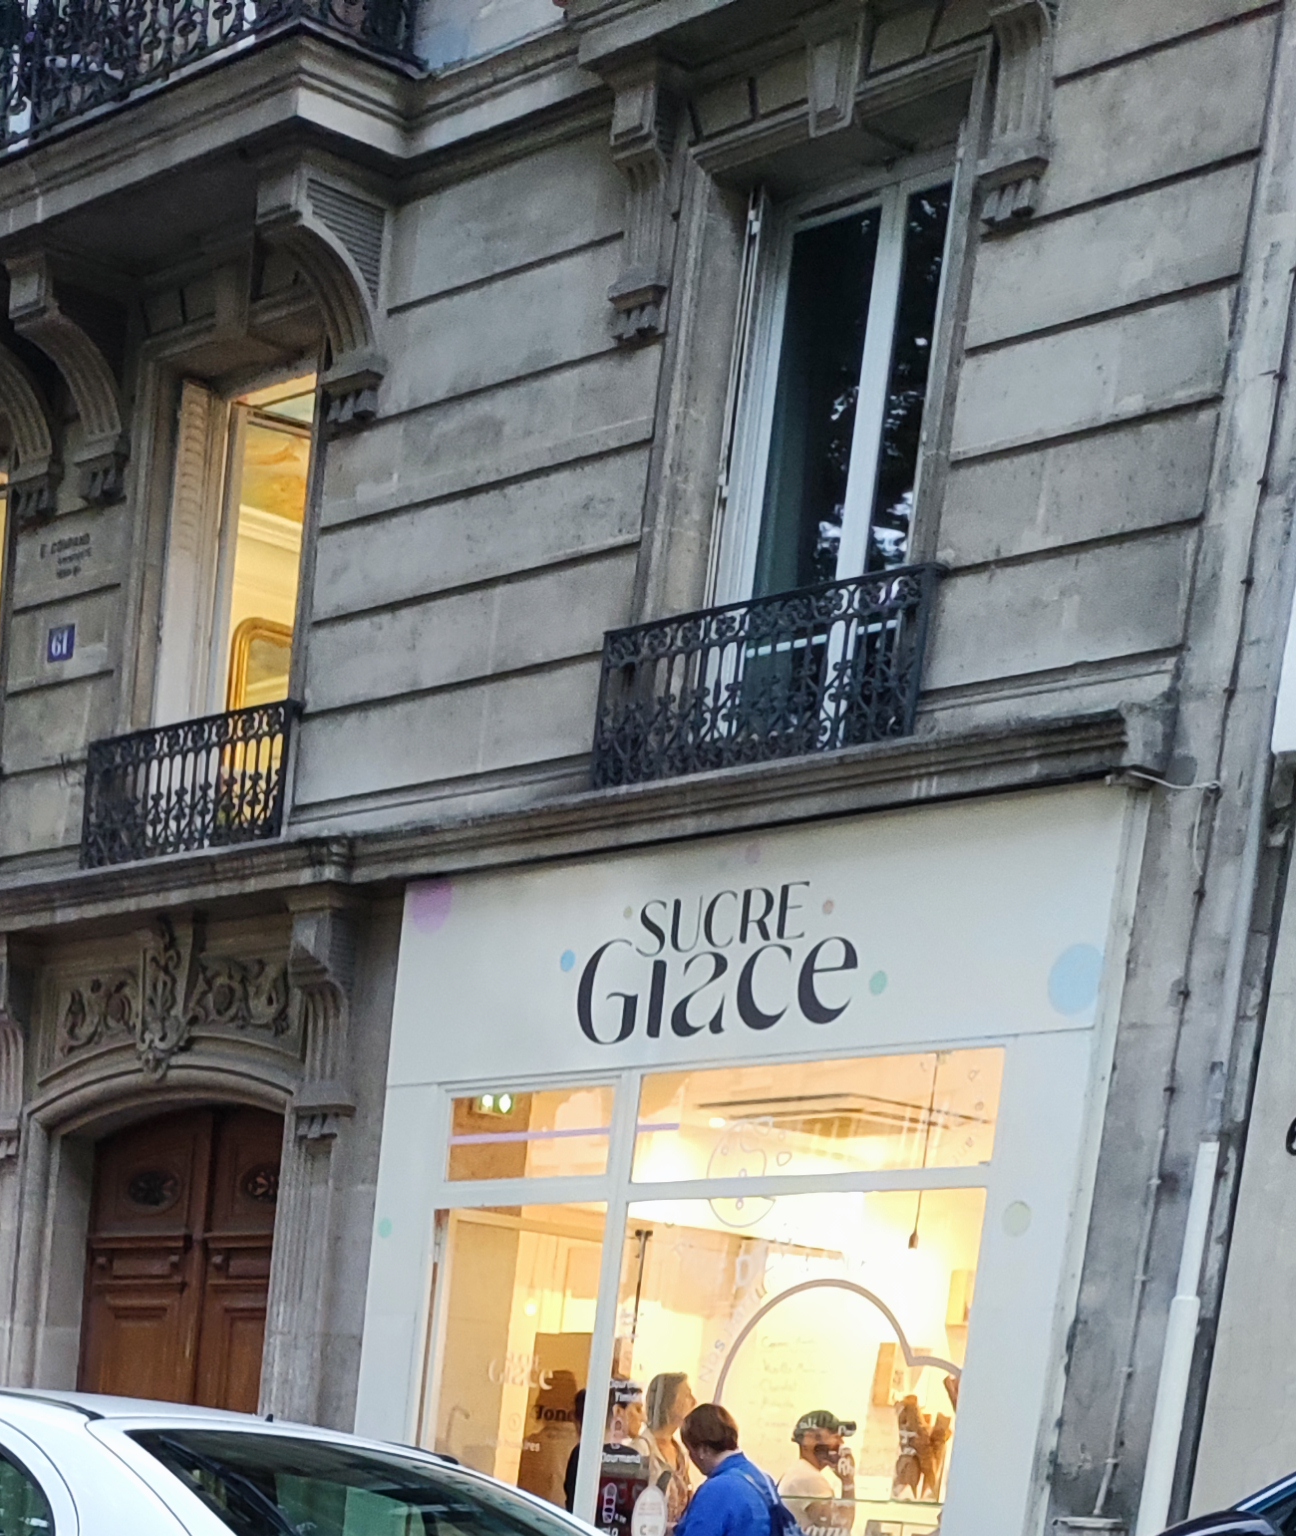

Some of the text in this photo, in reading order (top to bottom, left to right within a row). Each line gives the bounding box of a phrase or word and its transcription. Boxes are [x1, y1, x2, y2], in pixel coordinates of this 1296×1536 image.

[51, 629, 69, 657] 61
[636, 880, 810, 958] SUCRE
[576, 936, 858, 1045] Glace
